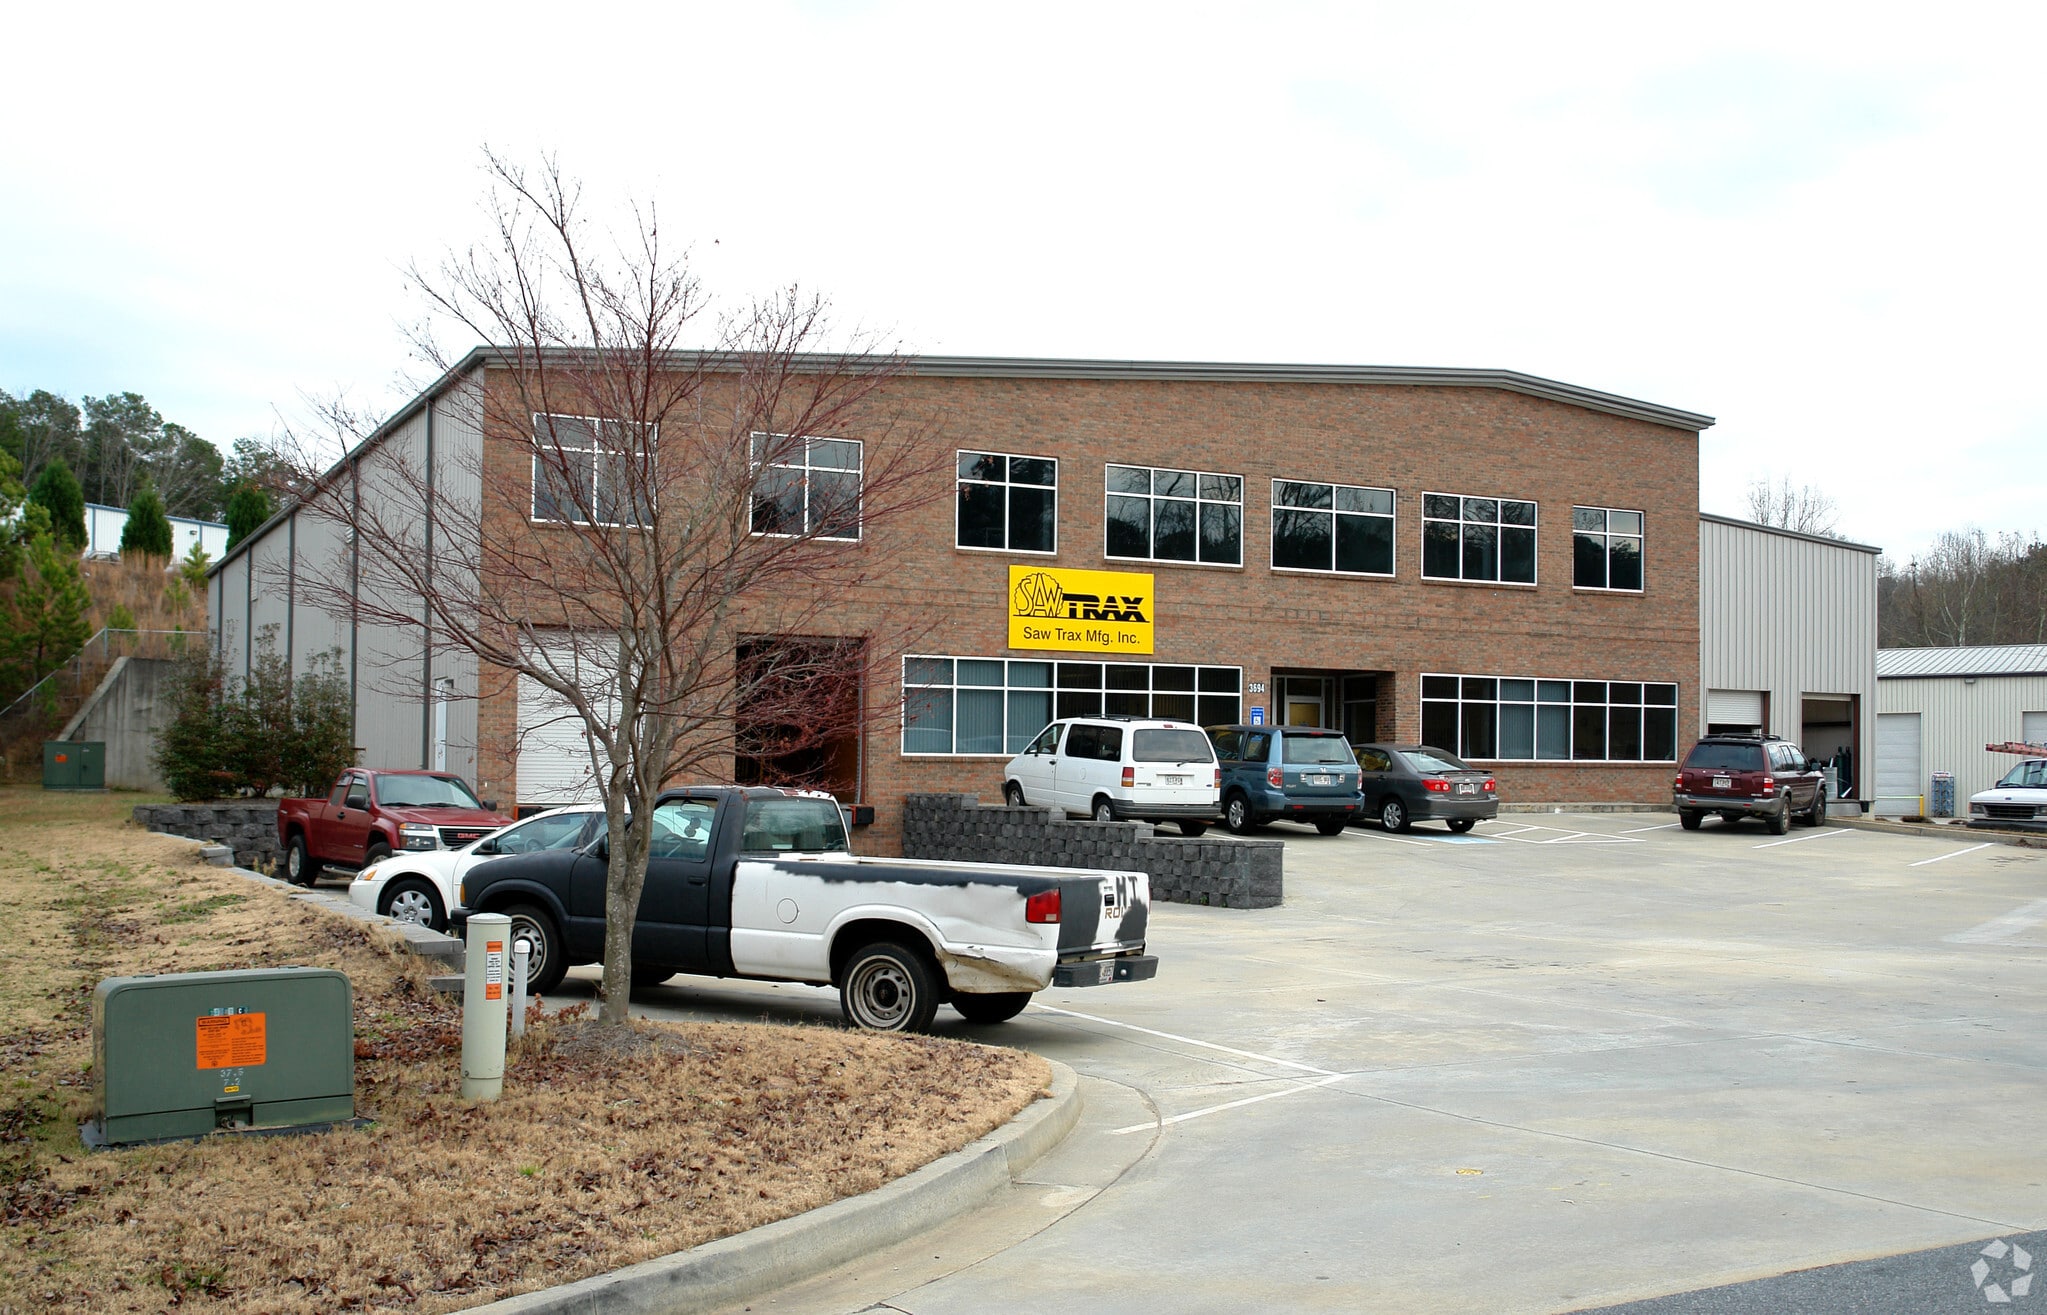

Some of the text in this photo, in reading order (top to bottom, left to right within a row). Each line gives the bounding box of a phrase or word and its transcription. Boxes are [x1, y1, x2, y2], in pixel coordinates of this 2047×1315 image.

[1019, 573, 1147, 622] SAW TRAX
[1023, 626, 1141, 646] Saw Trax Mfg. Inc.
